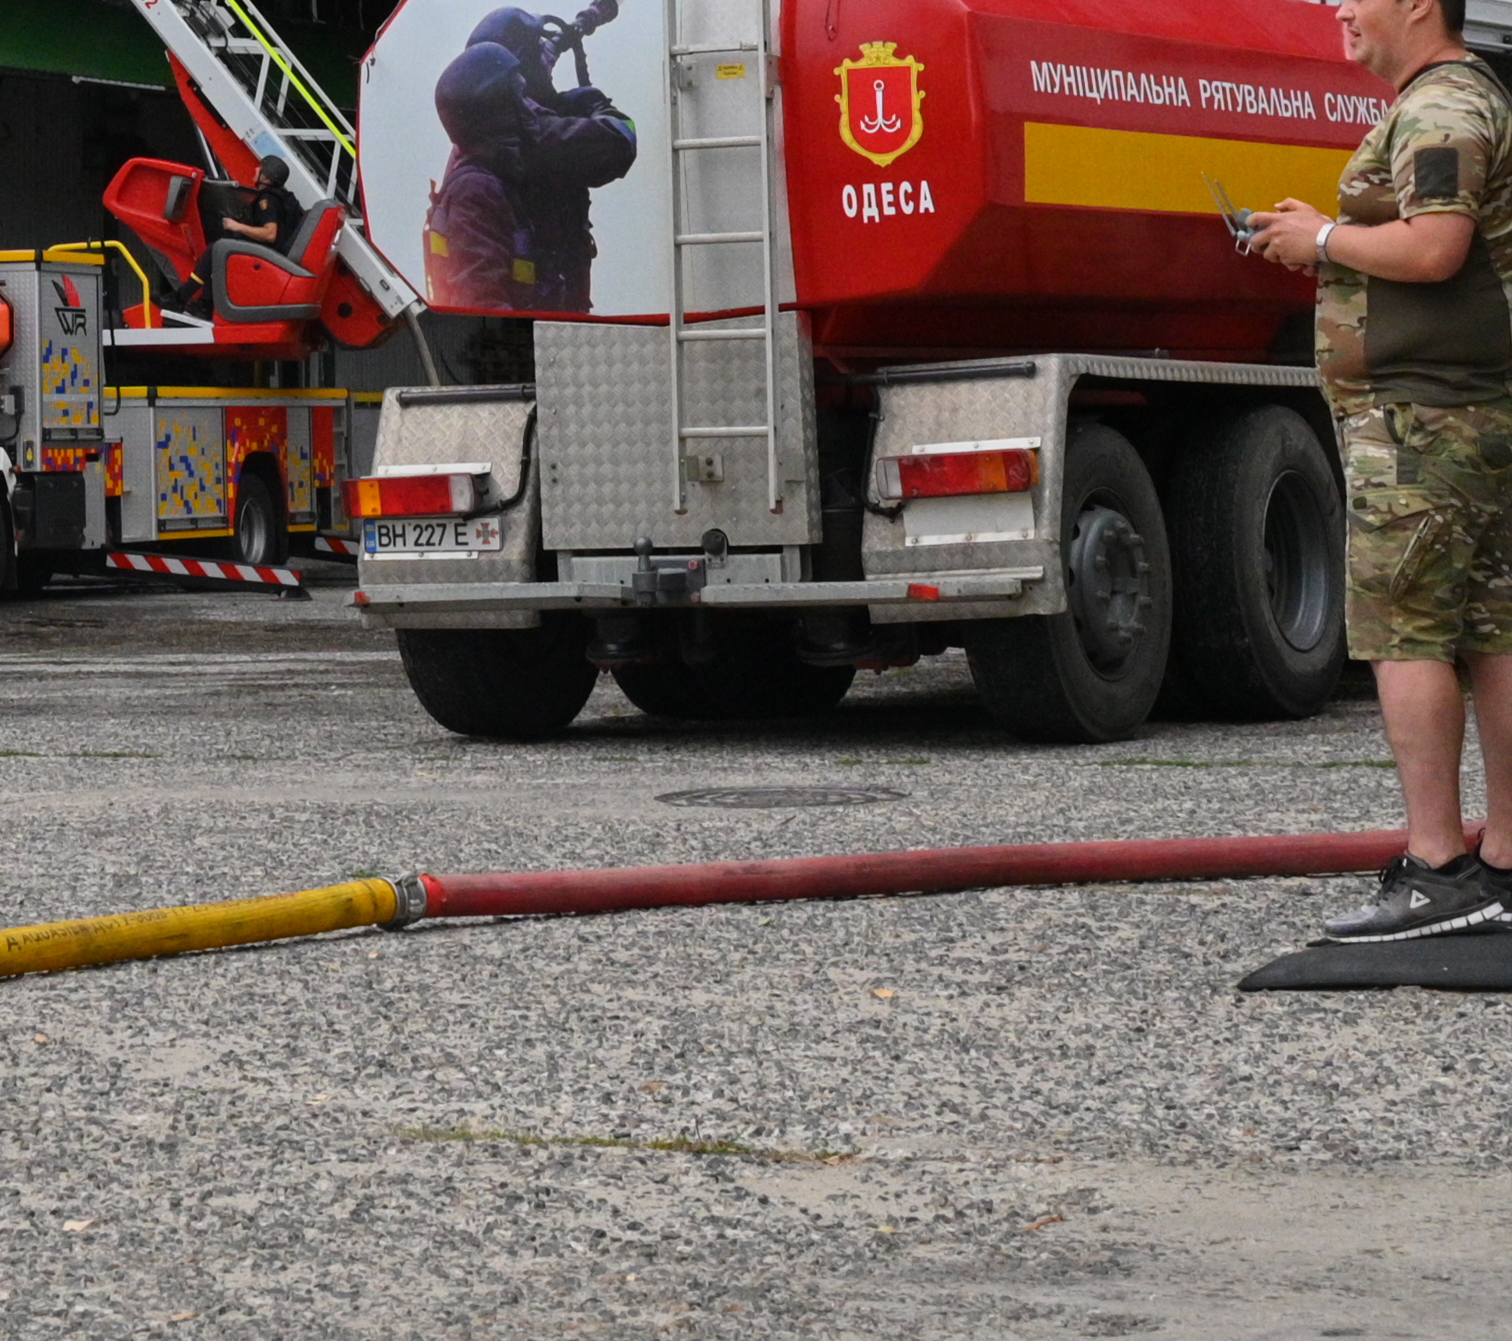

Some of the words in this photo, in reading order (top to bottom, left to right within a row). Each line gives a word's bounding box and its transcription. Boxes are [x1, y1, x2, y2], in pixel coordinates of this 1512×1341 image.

[1030, 60, 1191, 107] МУНІЦИПАЛЬНА
[1198, 78, 1317, 120] РЯТУВАЛЬНА
[842, 180, 935, 224] ОДЕСА
[378, 524, 406, 547] BH
[413, 523, 447, 547] 227
[454, 523, 469, 546] E
